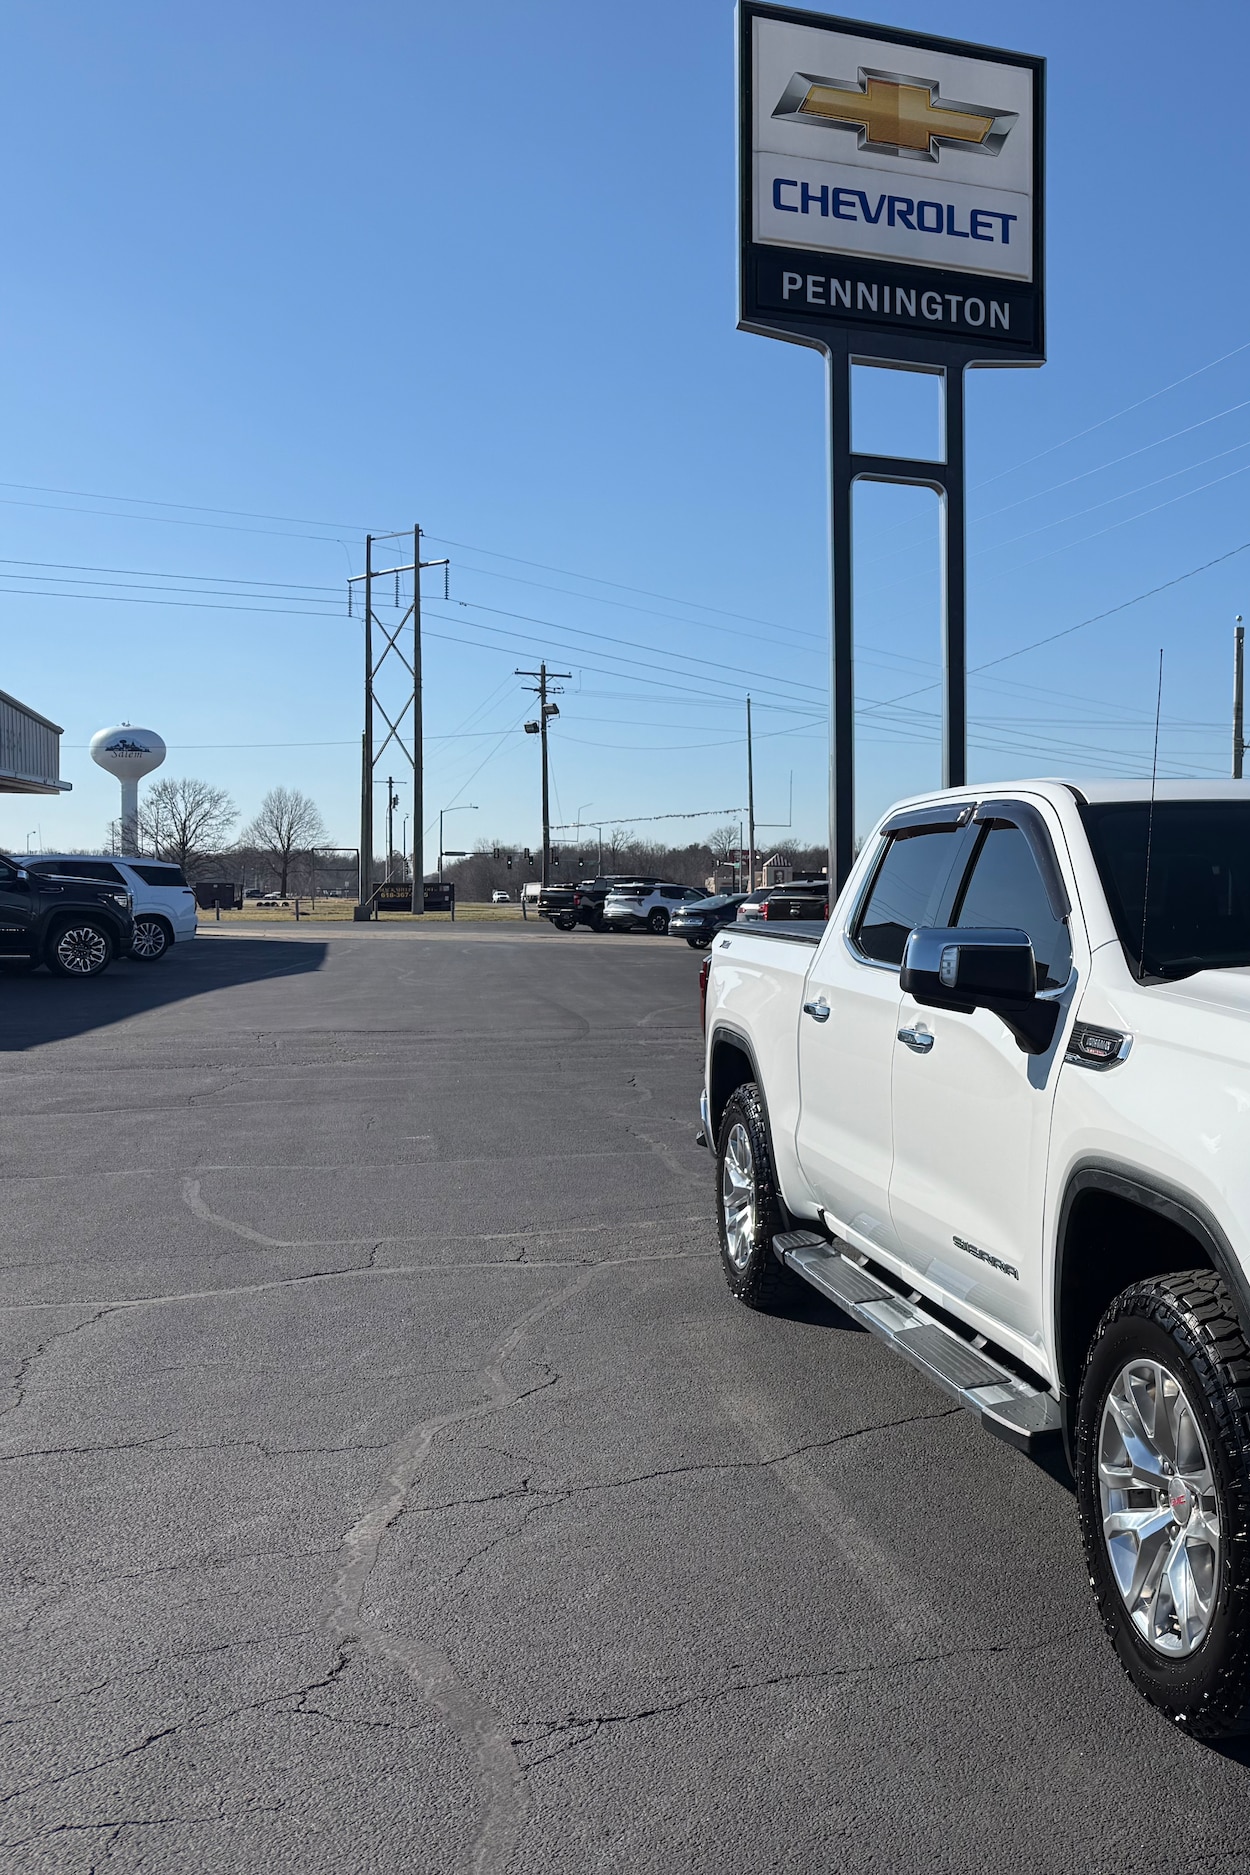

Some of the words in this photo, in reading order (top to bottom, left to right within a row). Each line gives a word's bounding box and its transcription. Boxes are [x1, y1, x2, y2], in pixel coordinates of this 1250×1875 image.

[772, 177, 1018, 245] CHEVROLET
[782, 271, 1010, 331] PENNINGTON
[111, 749, 143, 759] Salem
[952, 1235, 1020, 1281] SIERRA
